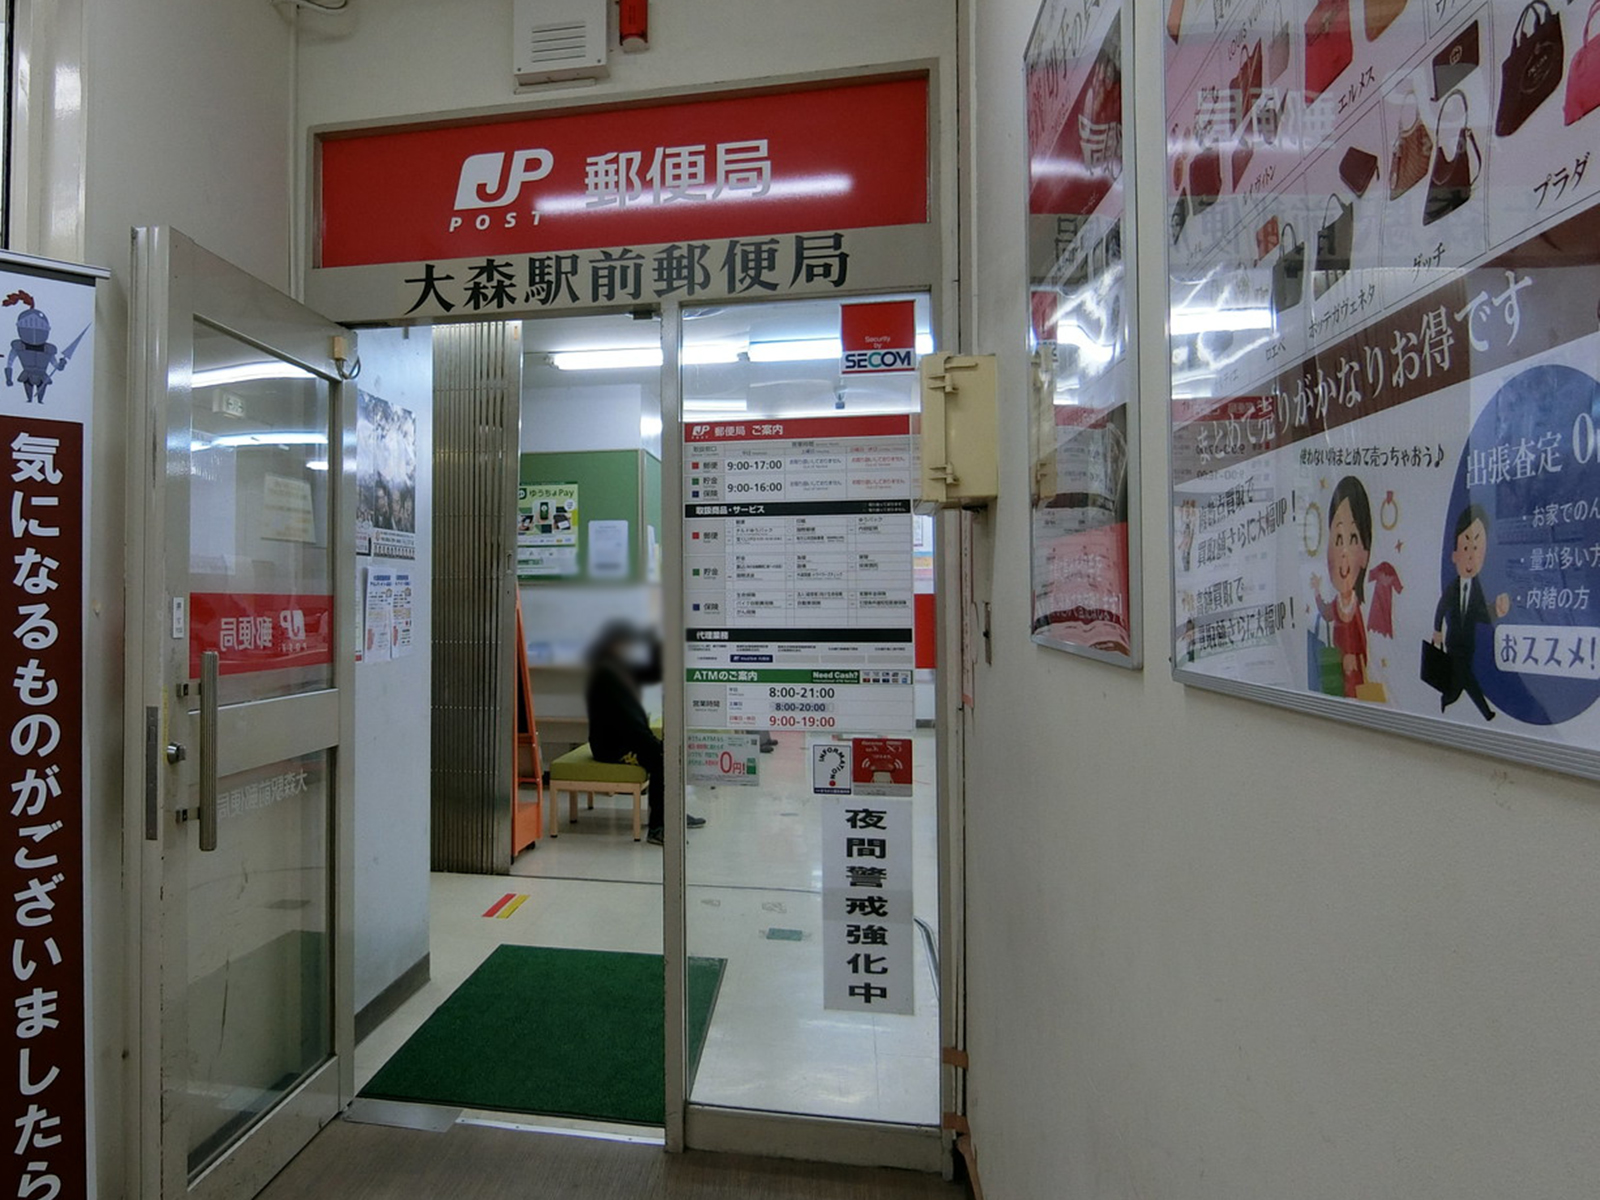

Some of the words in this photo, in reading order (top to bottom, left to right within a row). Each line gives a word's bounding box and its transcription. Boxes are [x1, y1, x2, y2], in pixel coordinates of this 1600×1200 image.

[1337, 66, 1376, 114] エルメス
[583, 138, 773, 211] 郵便局
[1533, 151, 1591, 210] プラダ
[448, 209, 544, 233] POST
[404, 231, 851, 316] 大森駅前郵便局
[845, 350, 912, 369] SECOM
[1195, 270, 1533, 466] まとめて売りがかなりお得です
[751, 424, 784, 436] ご案内
[727, 460, 783, 471] 9:00-17:00
[1465, 430, 1563, 490] 出張査定
[558, 488, 575, 498] Pay
[727, 482, 783, 493] 9:00-16:00
[1526, 585, 1590, 610] 内緒の方
[693, 670, 758, 681] ATMのご案内
[812, 671, 833, 679] Need
[834, 671, 859, 679] Cash?
[769, 686, 836, 699] 8:00-21:00
[775, 702, 826, 712] 8:00-20:00
[769, 715, 836, 727] 9:00-19:00
[10, 431, 65, 1200] 気になるものがございましたら
[845, 808, 889, 1005] 夜間警戒強化中
